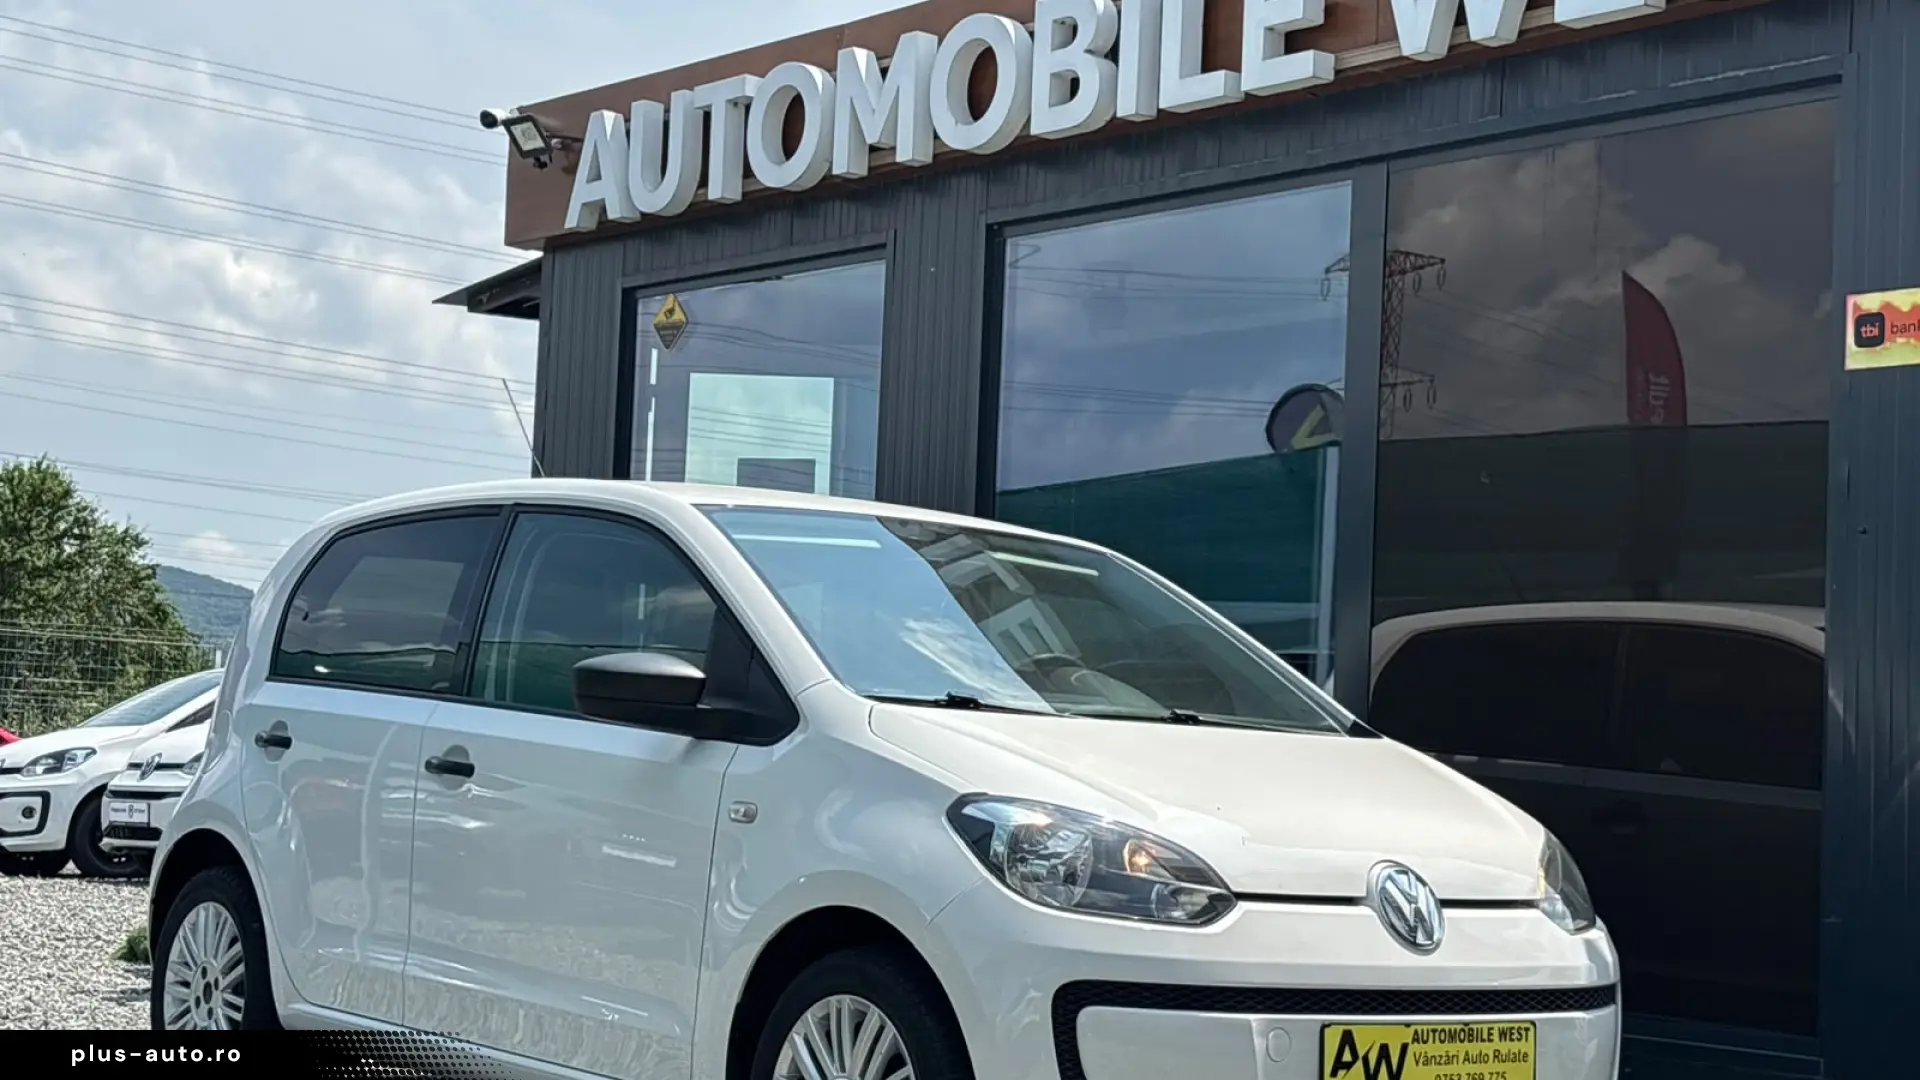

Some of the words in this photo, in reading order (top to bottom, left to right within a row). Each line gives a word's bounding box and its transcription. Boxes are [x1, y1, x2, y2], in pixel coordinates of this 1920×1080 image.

[564, 0, 1335, 231] AUTOMOBILE
[1859, 322, 1880, 338] tbi
[1890, 318, 1920, 335] ban
[1411, 1027, 1494, 1044] AUTOMOBILE
[1498, 1026, 1531, 1043] WEST
[1462, 1050, 1490, 1065] Auto
[1493, 1048, 1529, 1064] Rulate
